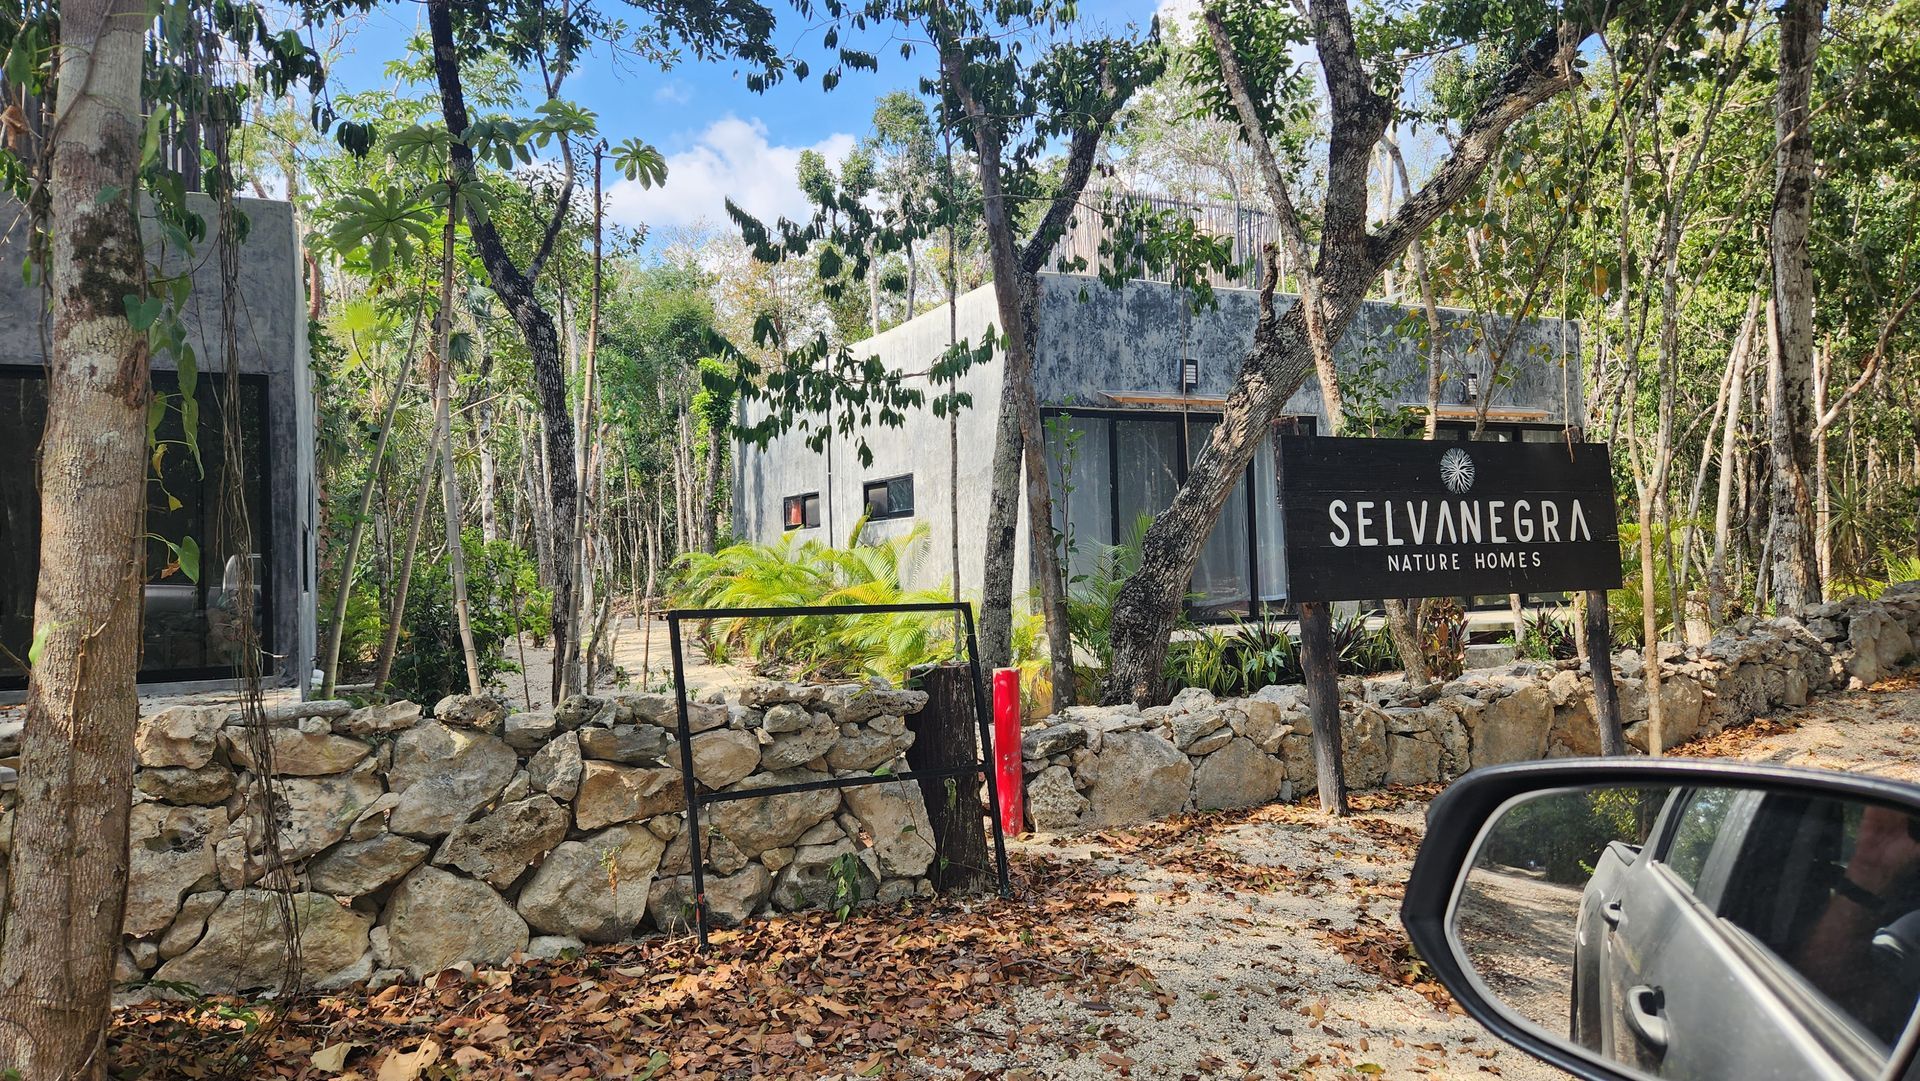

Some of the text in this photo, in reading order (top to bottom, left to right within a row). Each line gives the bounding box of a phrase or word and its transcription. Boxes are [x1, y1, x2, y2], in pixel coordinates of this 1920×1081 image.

[1328, 498, 1592, 548] SELVANEGRA
[1387, 551, 1542, 572] NATURE HOMES
